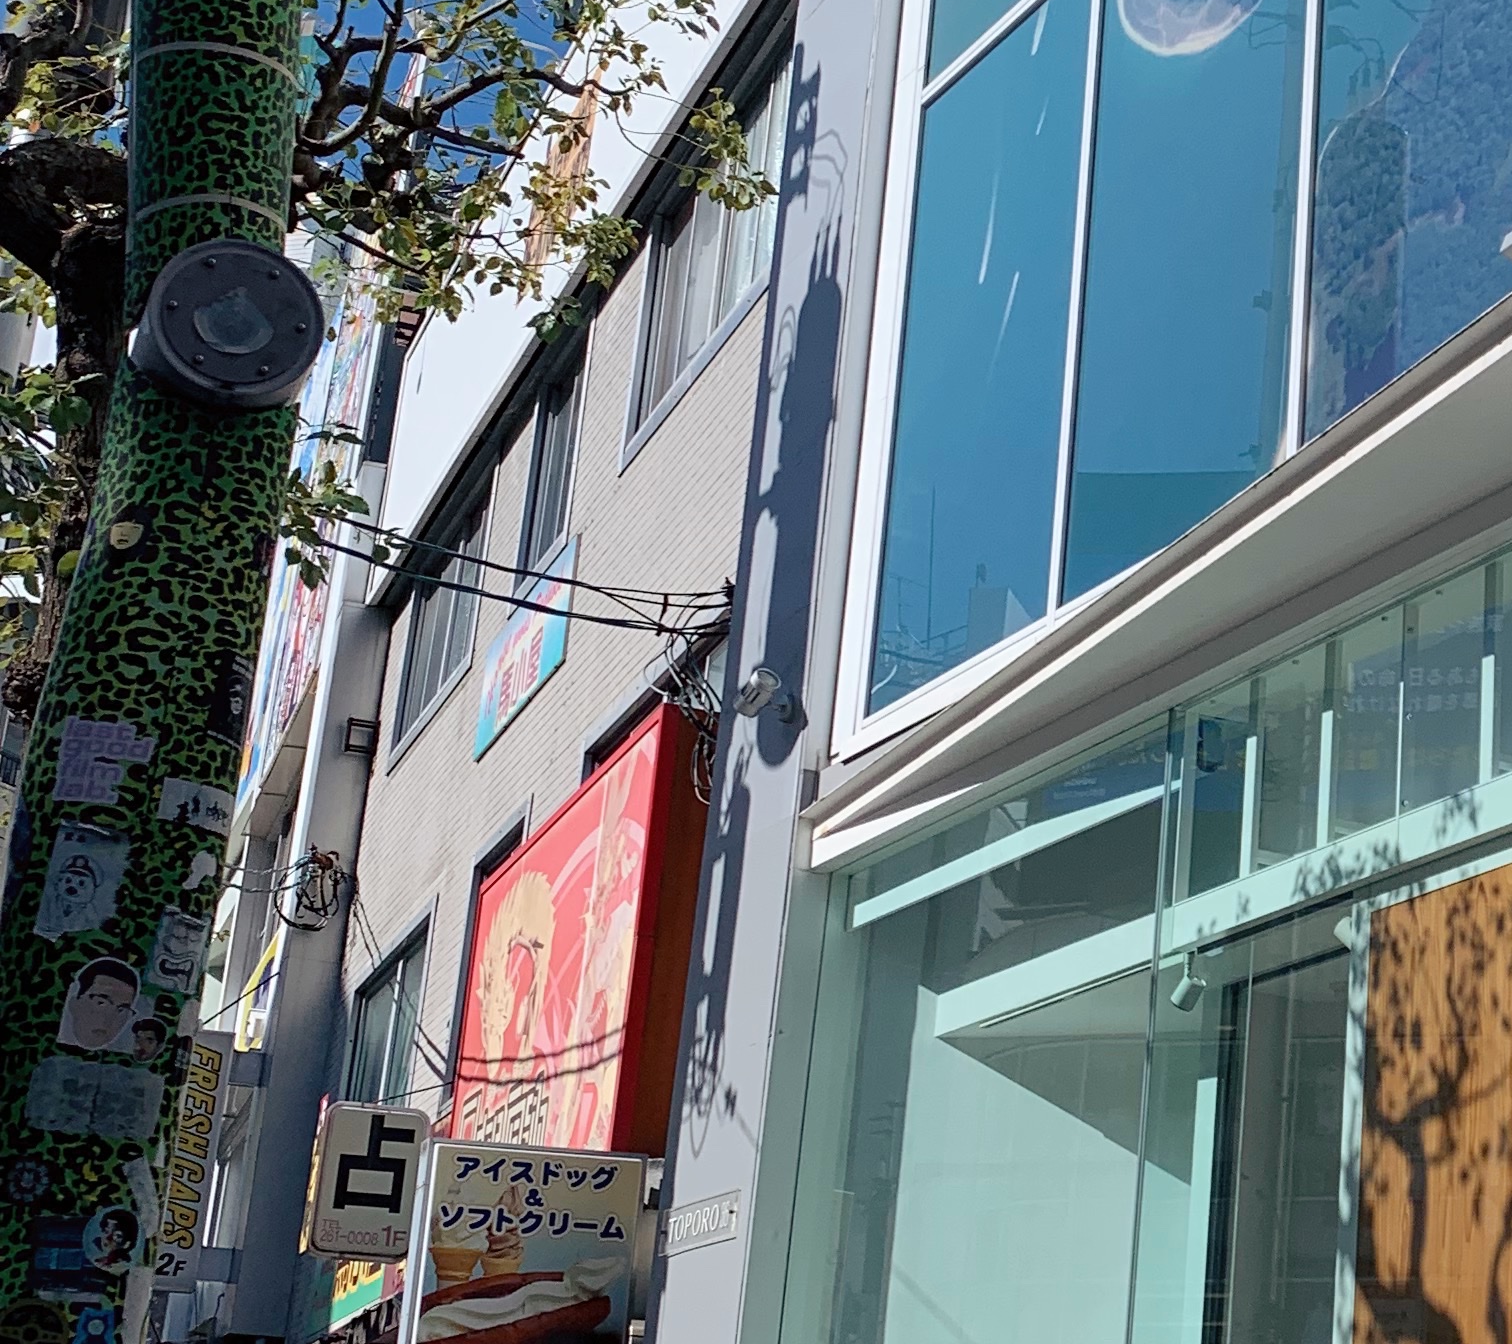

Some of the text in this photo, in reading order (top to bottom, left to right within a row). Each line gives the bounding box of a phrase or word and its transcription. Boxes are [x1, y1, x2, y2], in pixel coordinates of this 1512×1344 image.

[163, 1043, 223, 1251] FRESH CAPS
[332, 1114, 416, 1214] 占
[455, 1155, 619, 1191] アイスドッグ
[524, 1188, 544, 1208] &
[322, 1218, 342, 1229] TEL
[382, 1224, 407, 1247] 1F
[439, 1204, 625, 1240] ソフトクリーム
[155, 1252, 187, 1277] 2F
